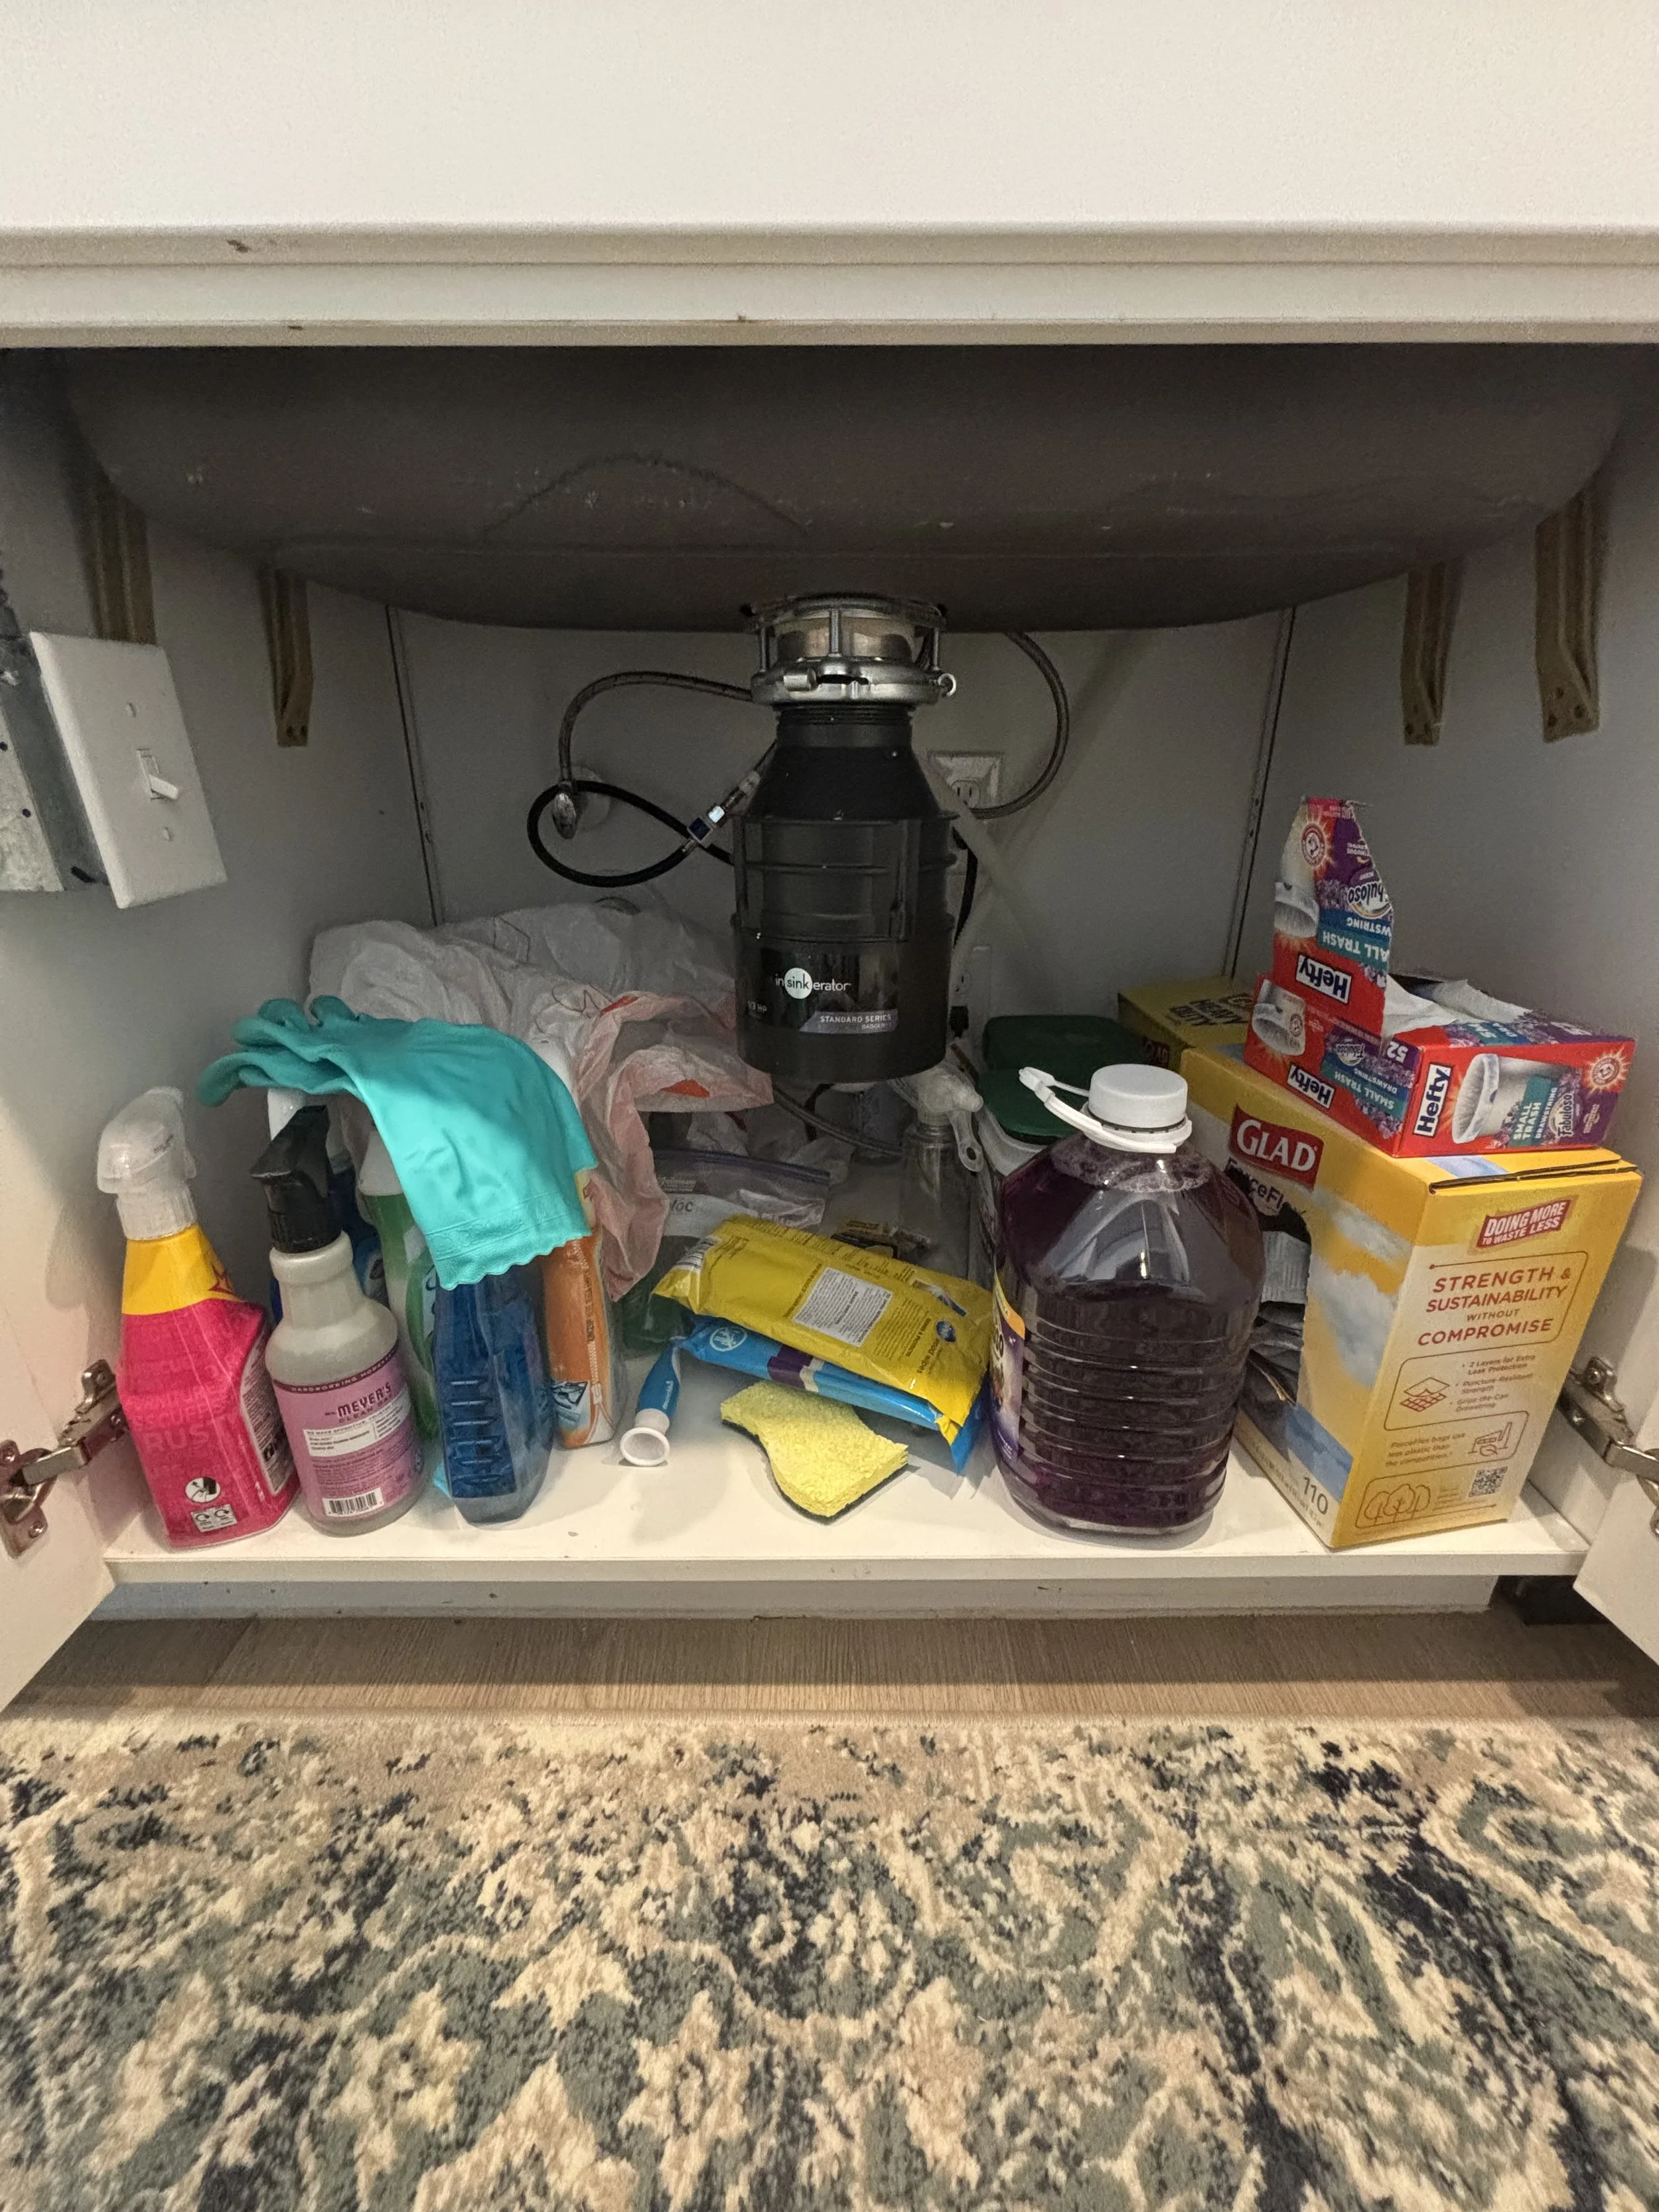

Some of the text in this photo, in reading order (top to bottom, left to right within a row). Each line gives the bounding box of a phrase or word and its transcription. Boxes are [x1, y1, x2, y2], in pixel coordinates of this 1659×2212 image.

[1323, 930, 1361, 954] TRASH
[1299, 957, 1350, 1000] Hefty
[865, 1013, 892, 1022] SERIES
[1386, 1041, 1409, 1063] 52
[1290, 1067, 1332, 1106] Hefty
[1334, 1070, 1395, 1110] SMALL TRASH
[1354, 1067, 1398, 1094] DRAWSTRING
[1417, 1066, 1450, 1133] Hefty
[1535, 1087, 1557, 1139] DRAWSTRING
[1557, 1094, 1573, 1137] Fabuloso
[1513, 1102, 1532, 1140] SMALL
[1522, 1102, 1542, 1140] TRASH
[1237, 1119, 1315, 1171] GLAD
[1481, 1216, 1561, 1246] TO WASTE LESS
[1484, 1201, 1567, 1238] DOING MORE
[1433, 1266, 1571, 1293] STRENGTH &
[1425, 1285, 1569, 1313] SUSTAINABILITY
[1467, 1309, 1520, 1322] WITHOUT
[1417, 1318, 1554, 1346] COMPROMISE
[337, 1381, 392, 1418] MEYER'S
[1301, 1476, 1328, 1515] 110
